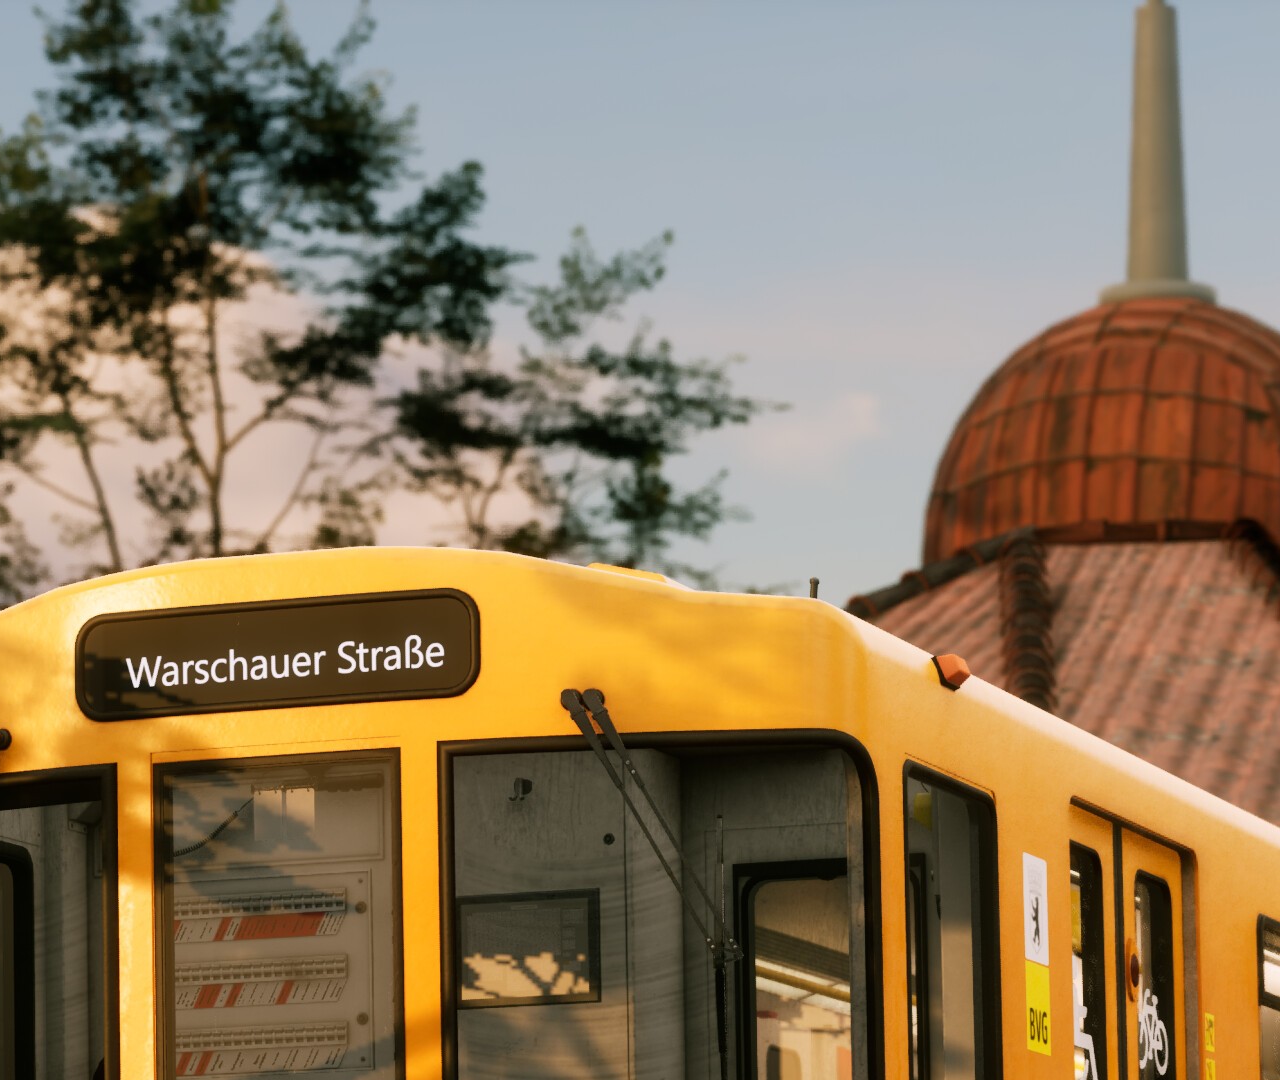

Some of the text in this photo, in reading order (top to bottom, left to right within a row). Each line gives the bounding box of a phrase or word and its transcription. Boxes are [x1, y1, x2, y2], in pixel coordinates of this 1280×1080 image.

[126, 635, 446, 688] Warschauer Straße
[1030, 1007, 1048, 1045] BVG
